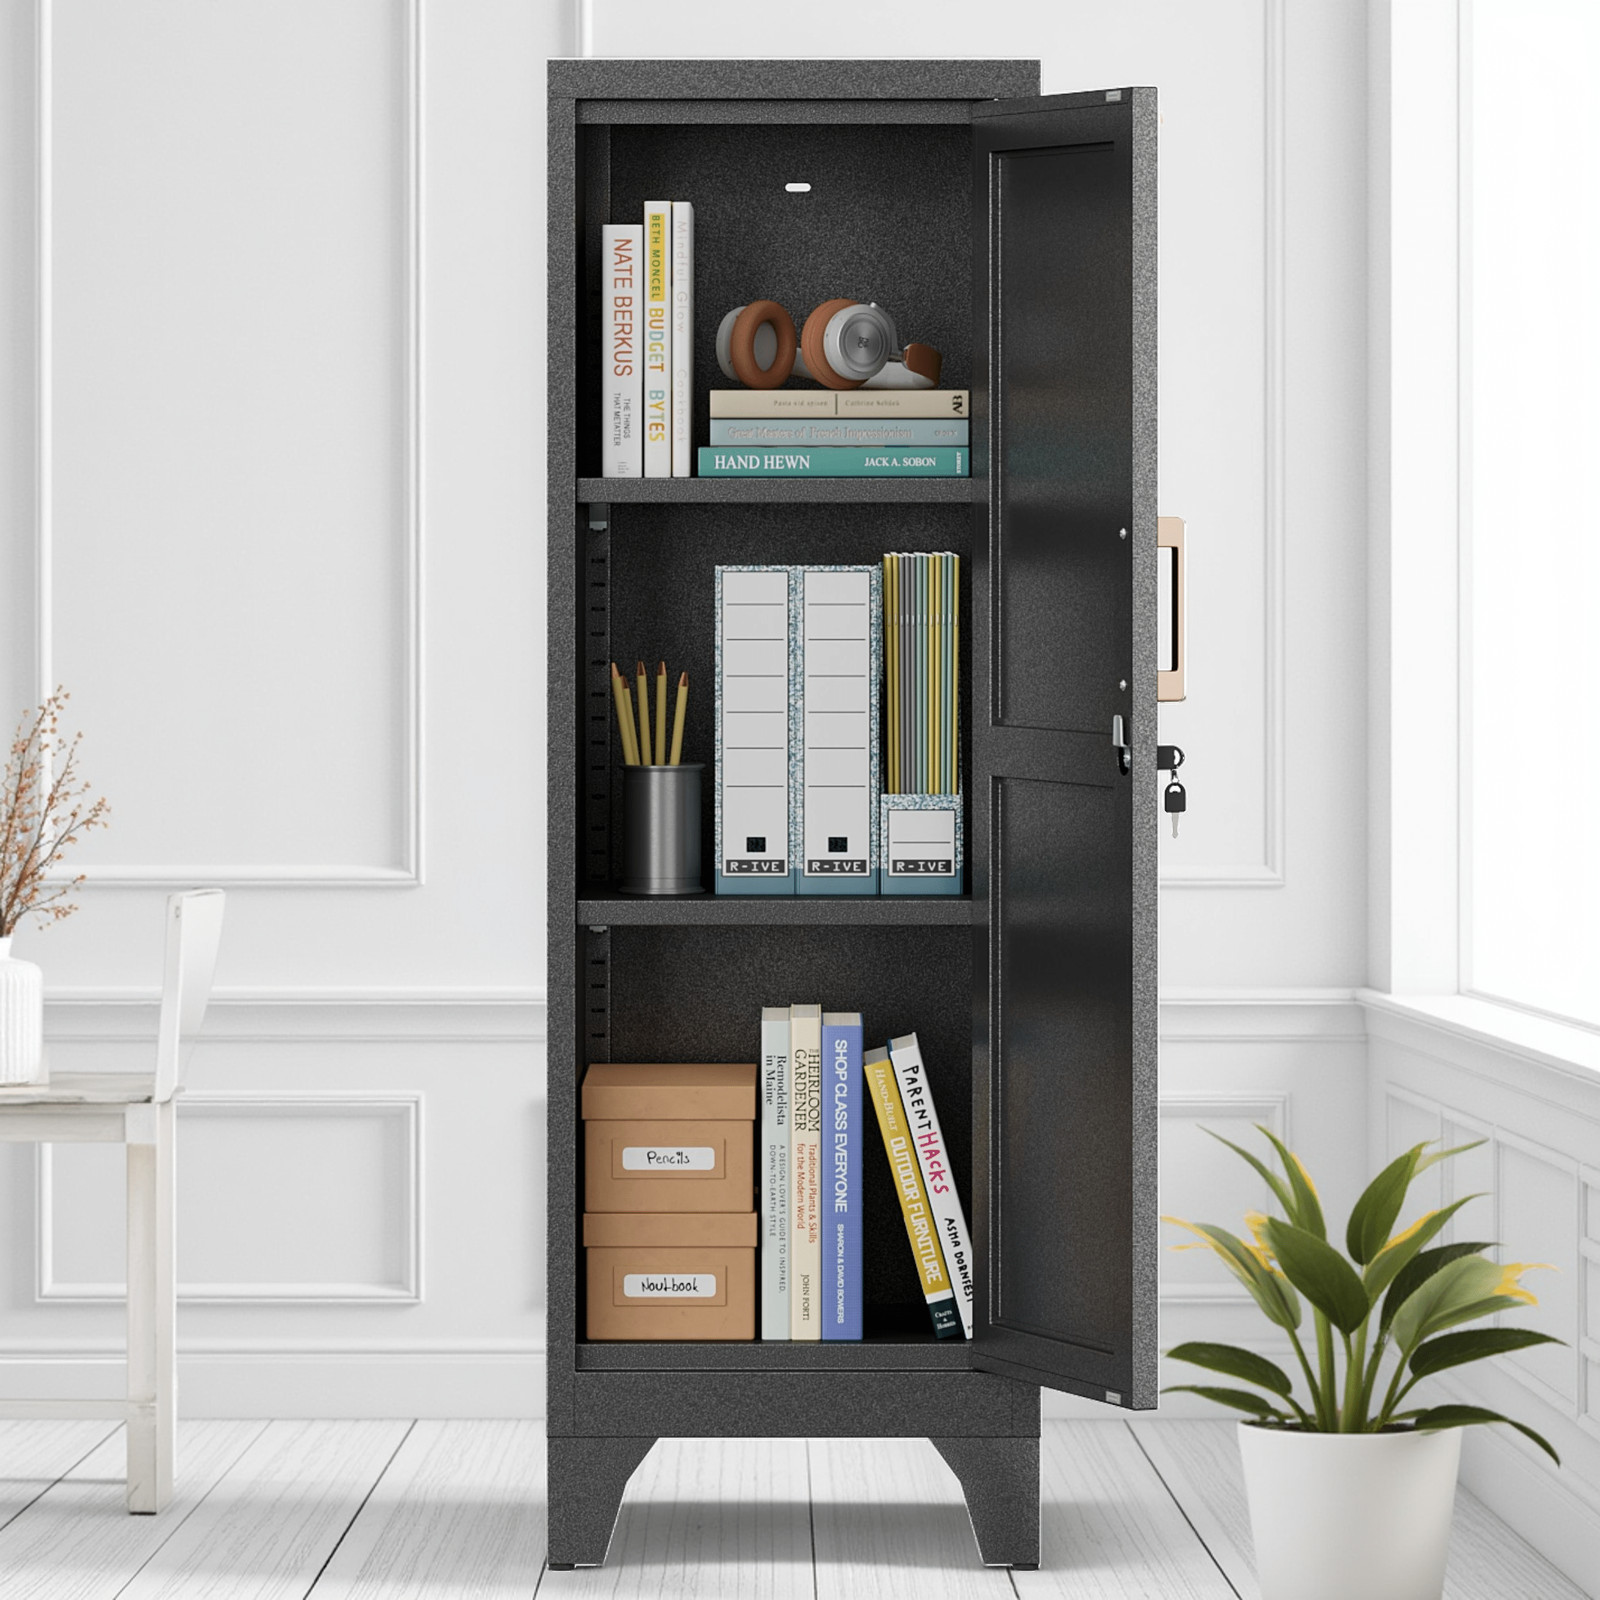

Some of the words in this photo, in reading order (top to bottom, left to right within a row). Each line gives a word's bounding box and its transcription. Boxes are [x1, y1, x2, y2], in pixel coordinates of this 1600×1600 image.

[651, 214, 661, 244] BETH
[613, 238, 633, 289] NATE
[651, 249, 661, 298] MONCEL
[676, 291, 688, 334] Glow
[613, 296, 633, 377] BERKUS
[648, 308, 665, 372] BUDGET
[613, 392, 622, 409] THAT
[623, 398, 631, 412] THE
[623, 413, 631, 439] THINGS
[648, 390, 665, 442] BYTES
[844, 426, 912, 440] Impressionism
[714, 455, 760, 470] HAND
[763, 455, 810, 470] HEWN
[864, 457, 890, 467] JACK
[891, 457, 901, 467] A.
[902, 457, 936, 467] SOBON
[730, 861, 780, 872] R-IVE
[811, 861, 862, 872] R-IVE
[896, 861, 947, 872] R-IVE
[765, 1055, 776, 1066] in
[834, 1039, 848, 1080] SHOP
[765, 1069, 776, 1105] Maine
[777, 1055, 788, 1126] Remodelista
[795, 1049, 808, 1132] GARDENER
[808, 1054, 820, 1132] HEIRLOOM
[834, 1083, 848, 1130] CLASS
[646, 1150, 690, 1165] Pencils
[797, 1143, 806, 1154] for
[797, 1157, 806, 1169] the
[769, 1144, 777, 1212] DOWN-TO-EARTH
[778, 1152, 786, 1181] DESIGN
[808, 1143, 818, 1186] Traditional
[834, 1133, 848, 1213] EVERYONE
[778, 1183, 786, 1215] LOVER'S
[797, 1171, 806, 1203] Modern
[808, 1187, 818, 1212] Plants
[797, 1205, 806, 1229] World
[890, 1136, 920, 1202] OUTDOOR
[907, 1202, 943, 1285] FURNITURE
[769, 1214, 777, 1237] STYLE
[778, 1217, 786, 1241] GUIDE
[808, 1222, 818, 1244] Skills
[837, 1223, 845, 1257] SHARON
[944, 1217, 961, 1248] ASMA
[778, 1243, 786, 1254] TO
[801, 1274, 810, 1296] JOHN
[837, 1265, 845, 1288] DAVID
[802, 1297, 810, 1321] FORTI
[837, 1289, 845, 1324] BOWERS
